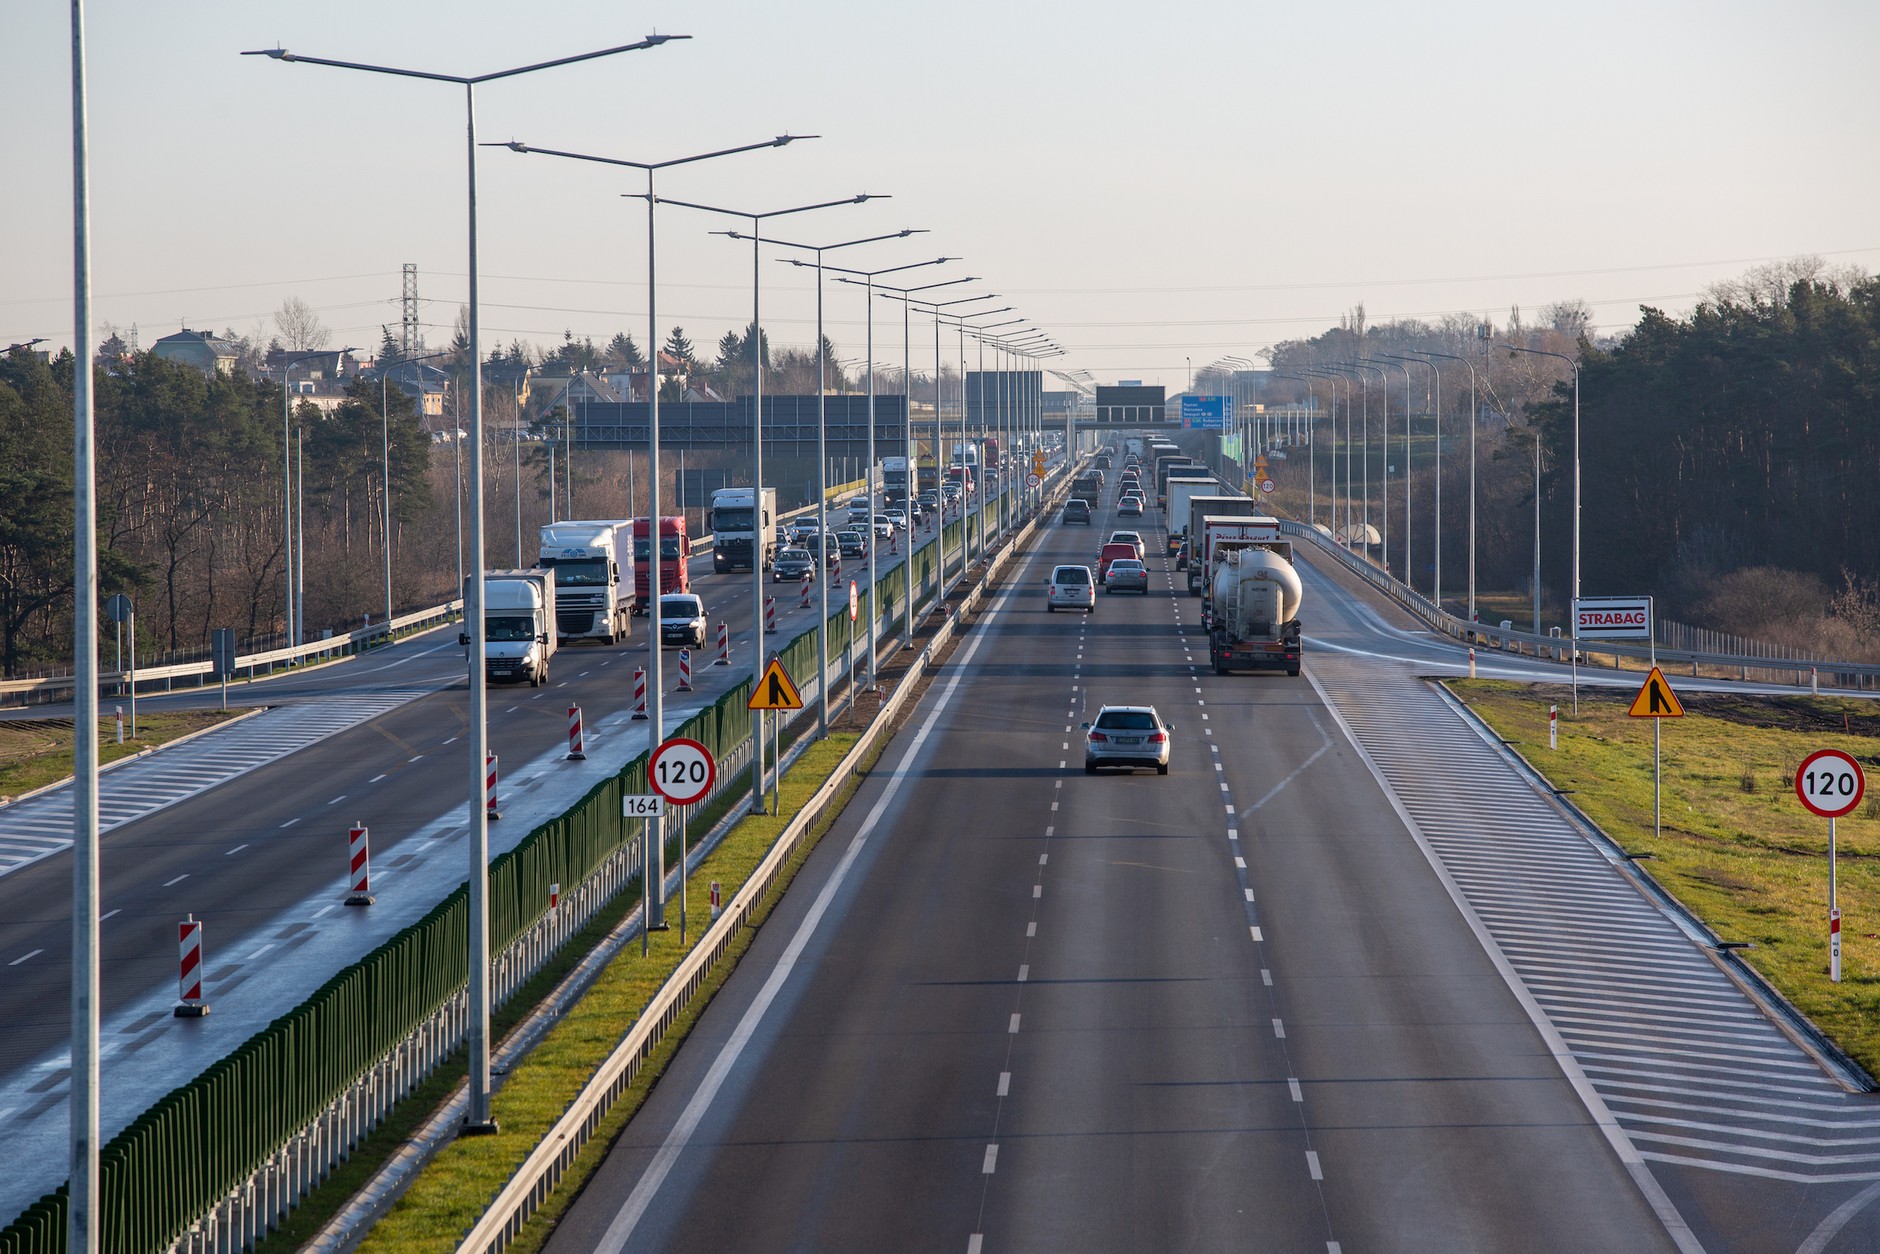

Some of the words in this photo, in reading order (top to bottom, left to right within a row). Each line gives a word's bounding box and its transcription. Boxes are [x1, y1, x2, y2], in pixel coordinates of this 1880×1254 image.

[1579, 612, 1646, 625] STRABAG
[658, 760, 705, 784] 120
[1806, 771, 1854, 796] 120
[628, 798, 658, 814] 164
